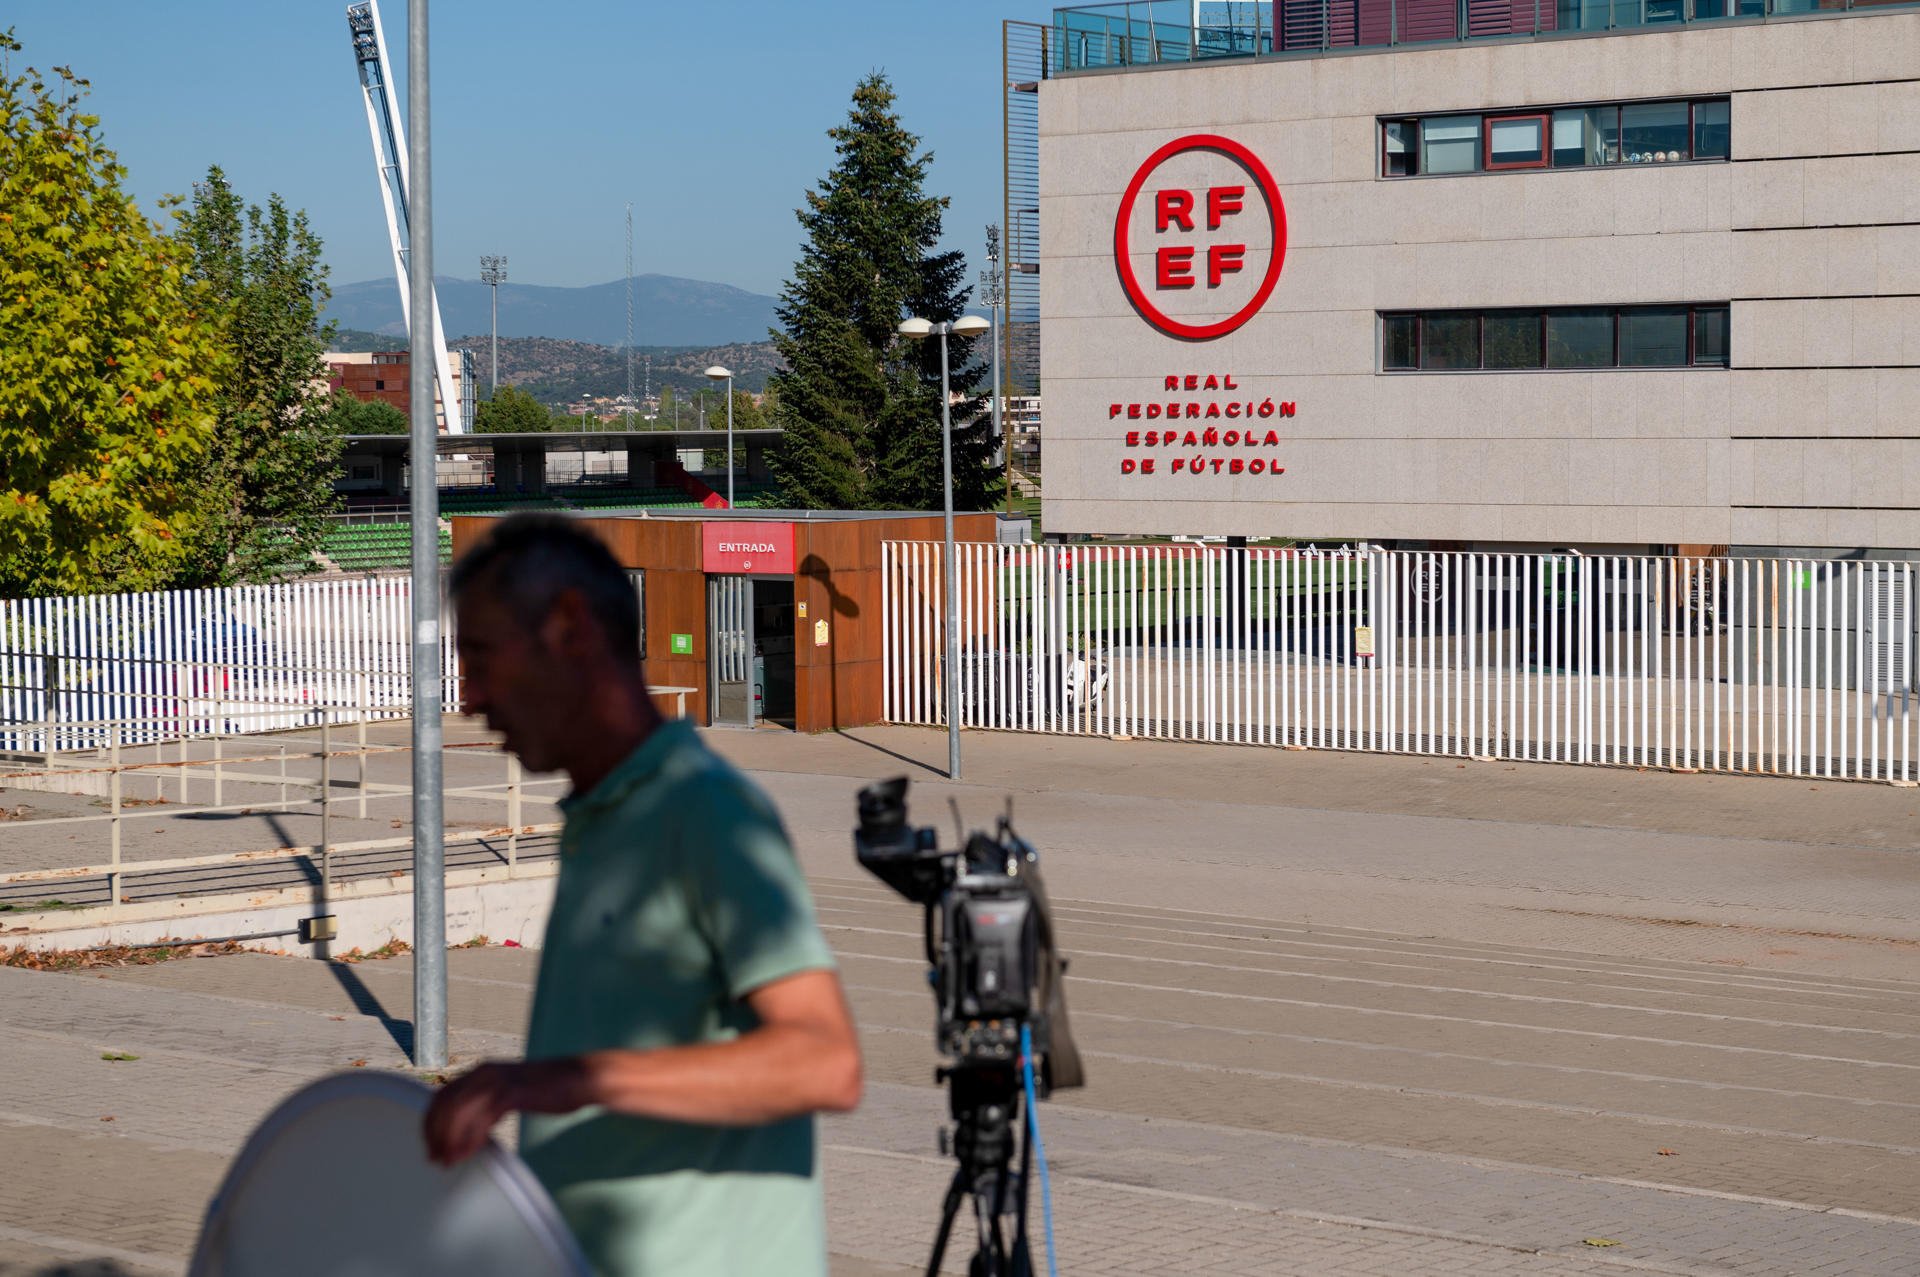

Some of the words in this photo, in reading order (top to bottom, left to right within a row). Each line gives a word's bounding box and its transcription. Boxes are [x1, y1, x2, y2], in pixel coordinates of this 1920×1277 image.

[1156, 185, 1246, 231] RF
[1156, 244, 1247, 288] EF
[1165, 374, 1239, 389] REAL
[1110, 398, 1297, 418] FEDERACIÓN
[1126, 427, 1280, 445] ESPAÑOLA
[1122, 458, 1156, 473] DE
[1172, 455, 1286, 473] FÚTBOL
[719, 543, 776, 553] ENTRADA
